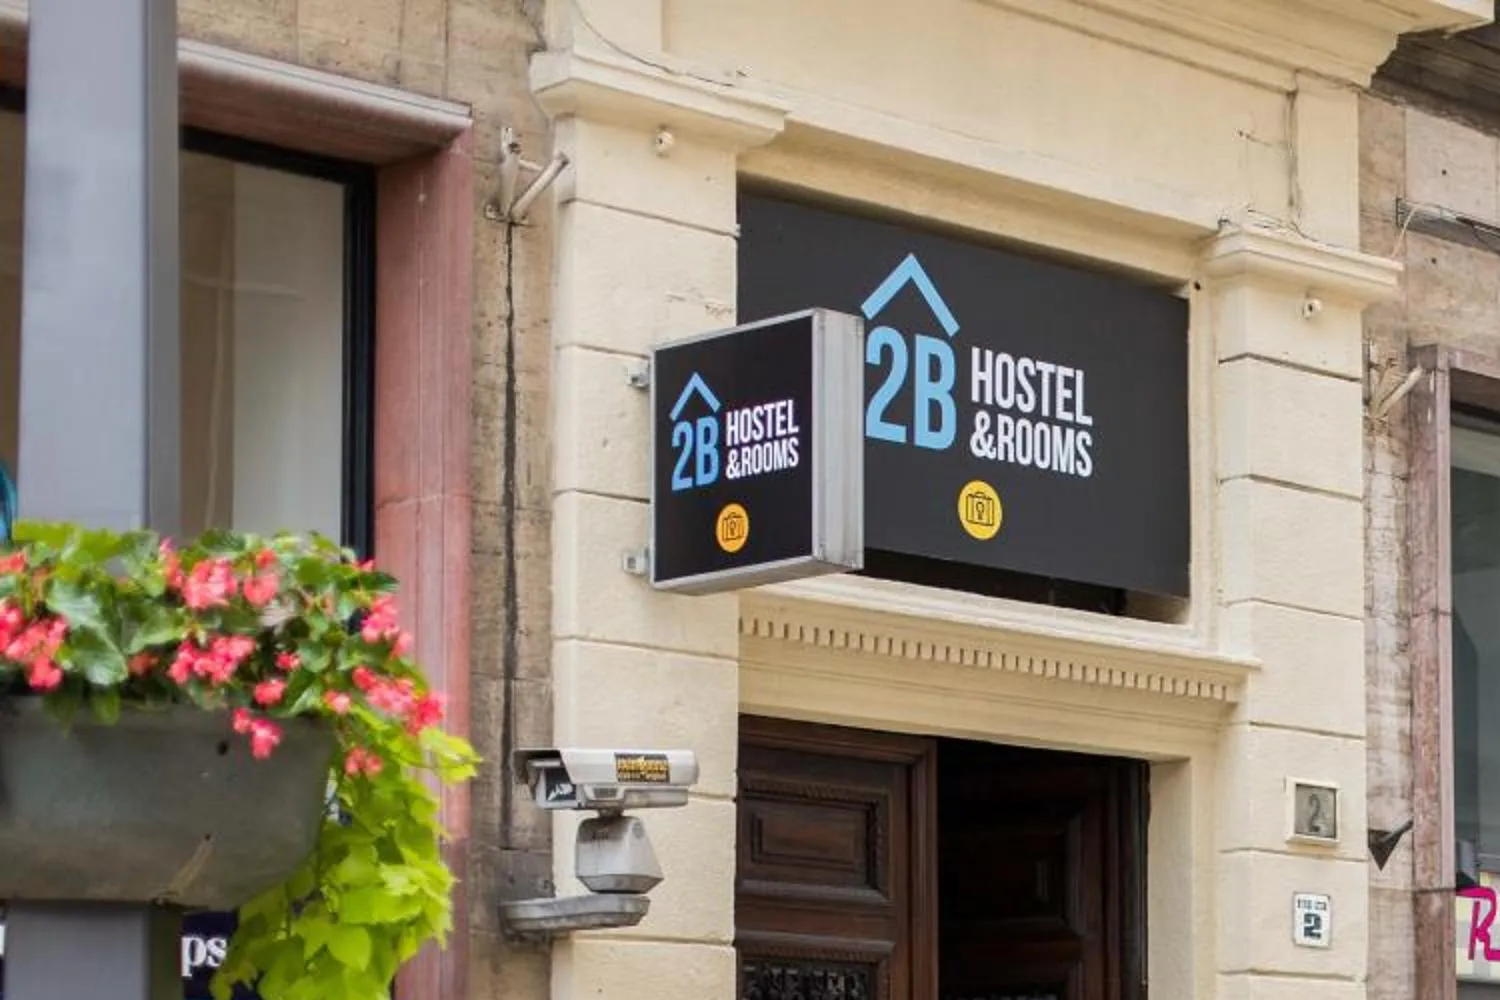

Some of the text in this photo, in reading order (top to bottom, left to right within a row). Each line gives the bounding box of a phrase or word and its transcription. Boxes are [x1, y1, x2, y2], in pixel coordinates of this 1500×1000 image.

[865, 325, 957, 450] 2B
[970, 345, 1093, 427] HOSTEL
[671, 415, 719, 491] 2B
[725, 434, 799, 479] &ROOMS
[726, 399, 799, 446] HOSTEL
[969, 410, 1093, 478] &ROOMS
[1304, 913, 1322, 939] 2
